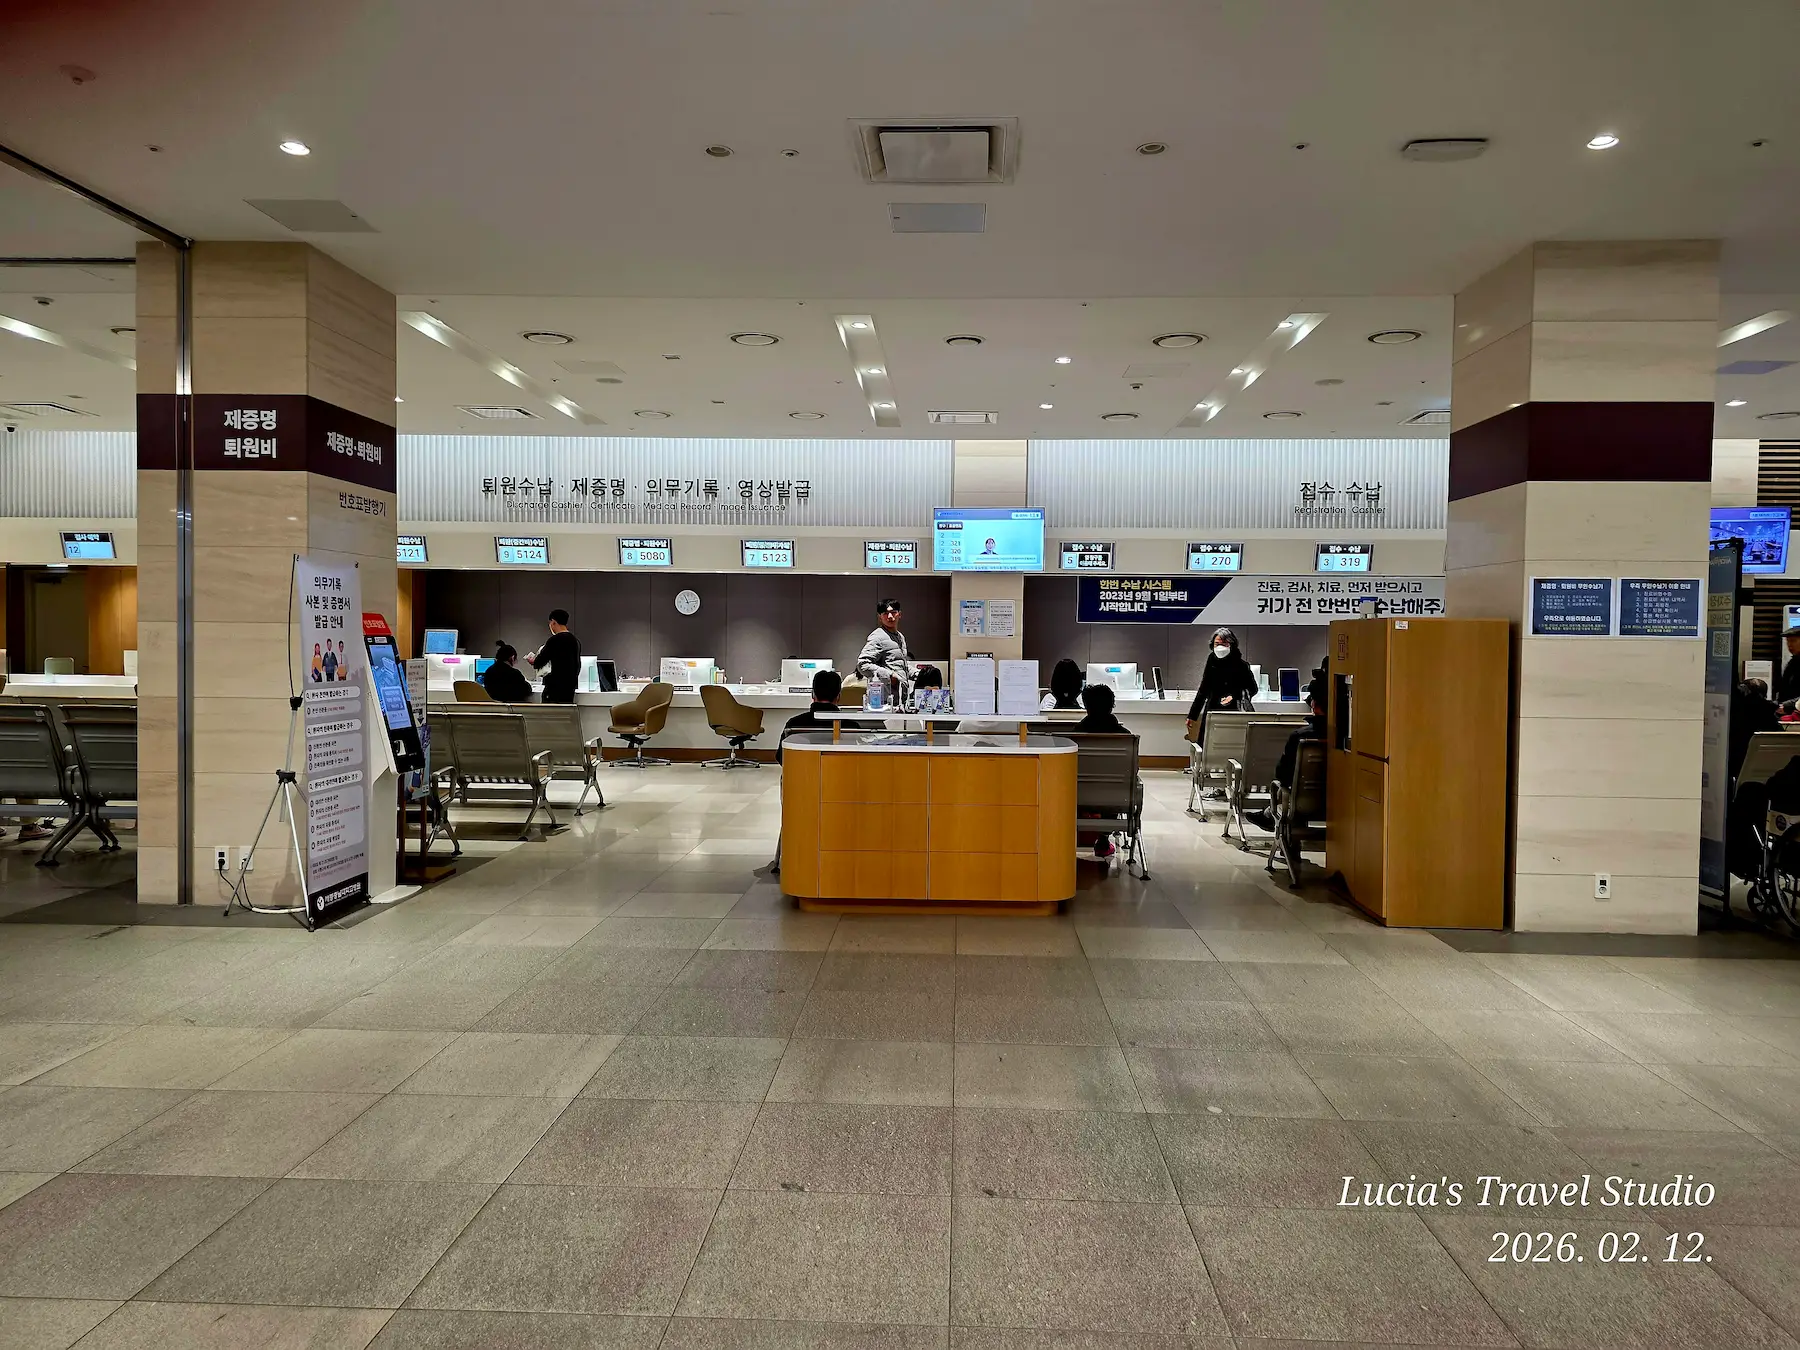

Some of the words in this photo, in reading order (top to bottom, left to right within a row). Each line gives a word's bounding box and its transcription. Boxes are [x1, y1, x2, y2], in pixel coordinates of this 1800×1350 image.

[224, 409, 277, 430] 제증명
[224, 437, 277, 458] 퇴원비
[482, 476, 553, 496] 퇴원수납
[571, 477, 625, 497] 제증명
[646, 478, 720, 498] 의무기록
[738, 479, 812, 498] 영상발급
[339, 492, 386, 516] 번호표발행기
[506, 501, 549, 510] Discharge
[719, 503, 746, 512] Image
[1294, 506, 1346, 515] Registration
[1352, 506, 1386, 514] Cashier
[517, 550, 542, 558] 5124
[640, 552, 665, 560] 5080
[762, 554, 787, 562] 5123
[885, 555, 910, 564] 5125
[1212, 557, 1231, 565] 270
[1340, 558, 1360, 566] 319
[314, 576, 342, 591] 의무기록
[1100, 580, 1119, 590] 한번
[1121, 580, 1141, 590] 수납
[1142, 580, 1172, 590] 시스템
[1258, 582, 1284, 594] 진료,
[1288, 582, 1314, 594] 검사,
[1318, 582, 1344, 594] 치료,
[1348, 582, 1371, 593] 먼저
[1375, 582, 1422, 593] 받으시고
[1100, 591, 1133, 601] 2023년
[1135, 591, 1150, 601] 9월
[1153, 591, 1188, 601] 1일부터
[306, 595, 320, 609] 사본
[322, 596, 329, 610] 및
[330, 597, 350, 610] 증명서
[1099, 602, 1147, 612] 시작합니다
[1258, 598, 1291, 614] 귀가
[1296, 598, 1312, 614] 전
[315, 615, 328, 628] 발급
[330, 616, 343, 628] 안내
